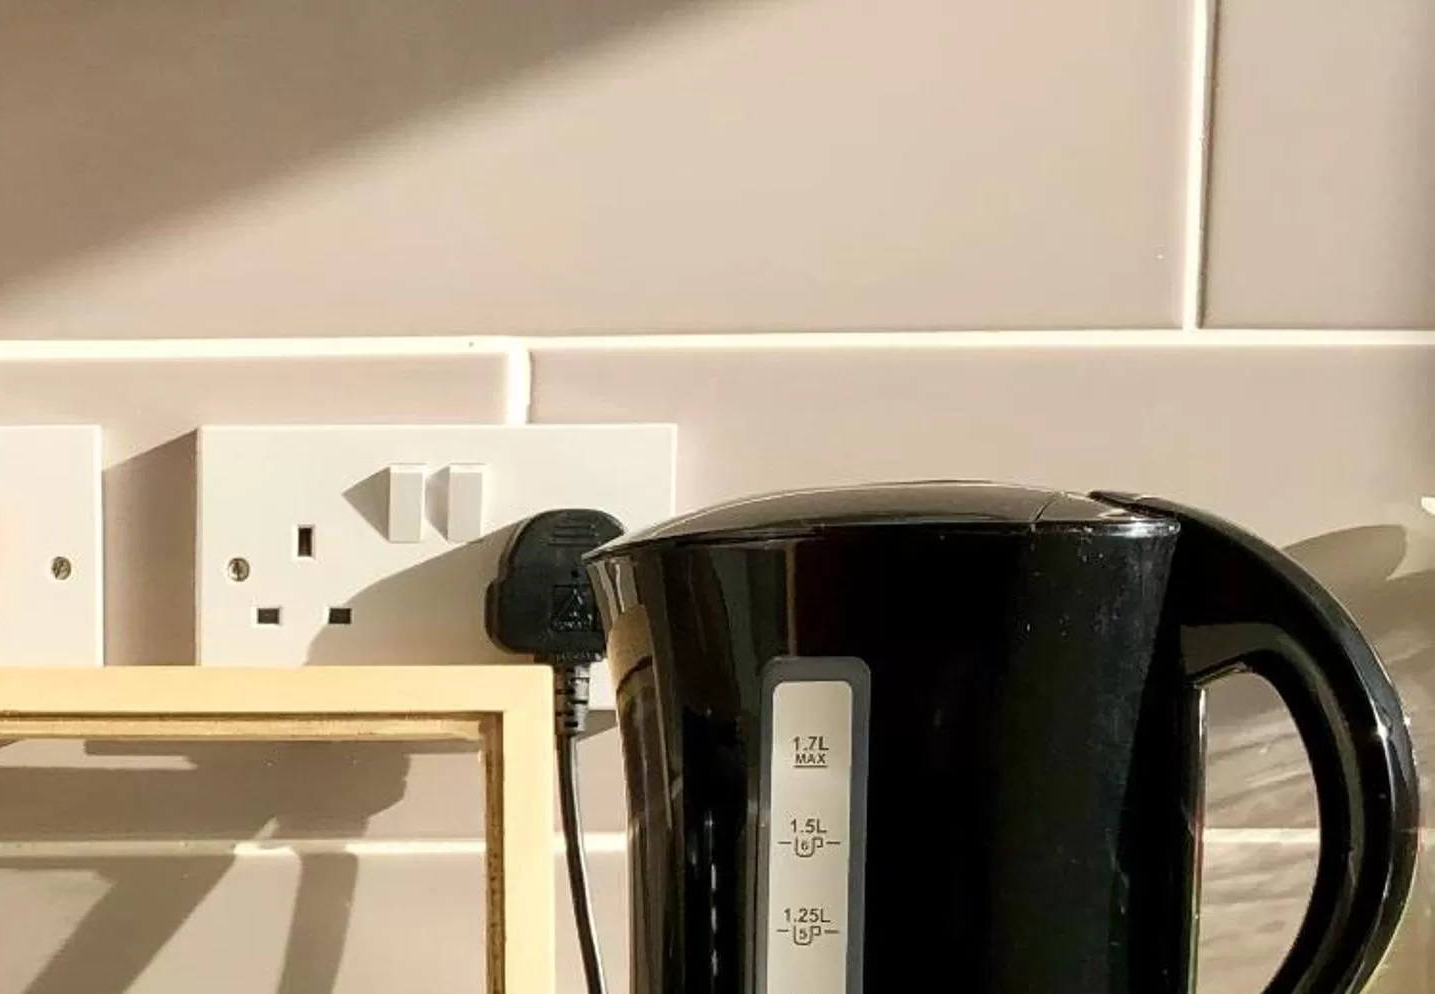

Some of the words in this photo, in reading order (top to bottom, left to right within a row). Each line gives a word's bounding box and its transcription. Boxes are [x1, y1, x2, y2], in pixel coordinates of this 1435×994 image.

[793, 736, 829, 751] 1.7L
[795, 753, 826, 764] MAX
[790, 819, 827, 834] 1.5L
[784, 908, 831, 923] 1.25L
